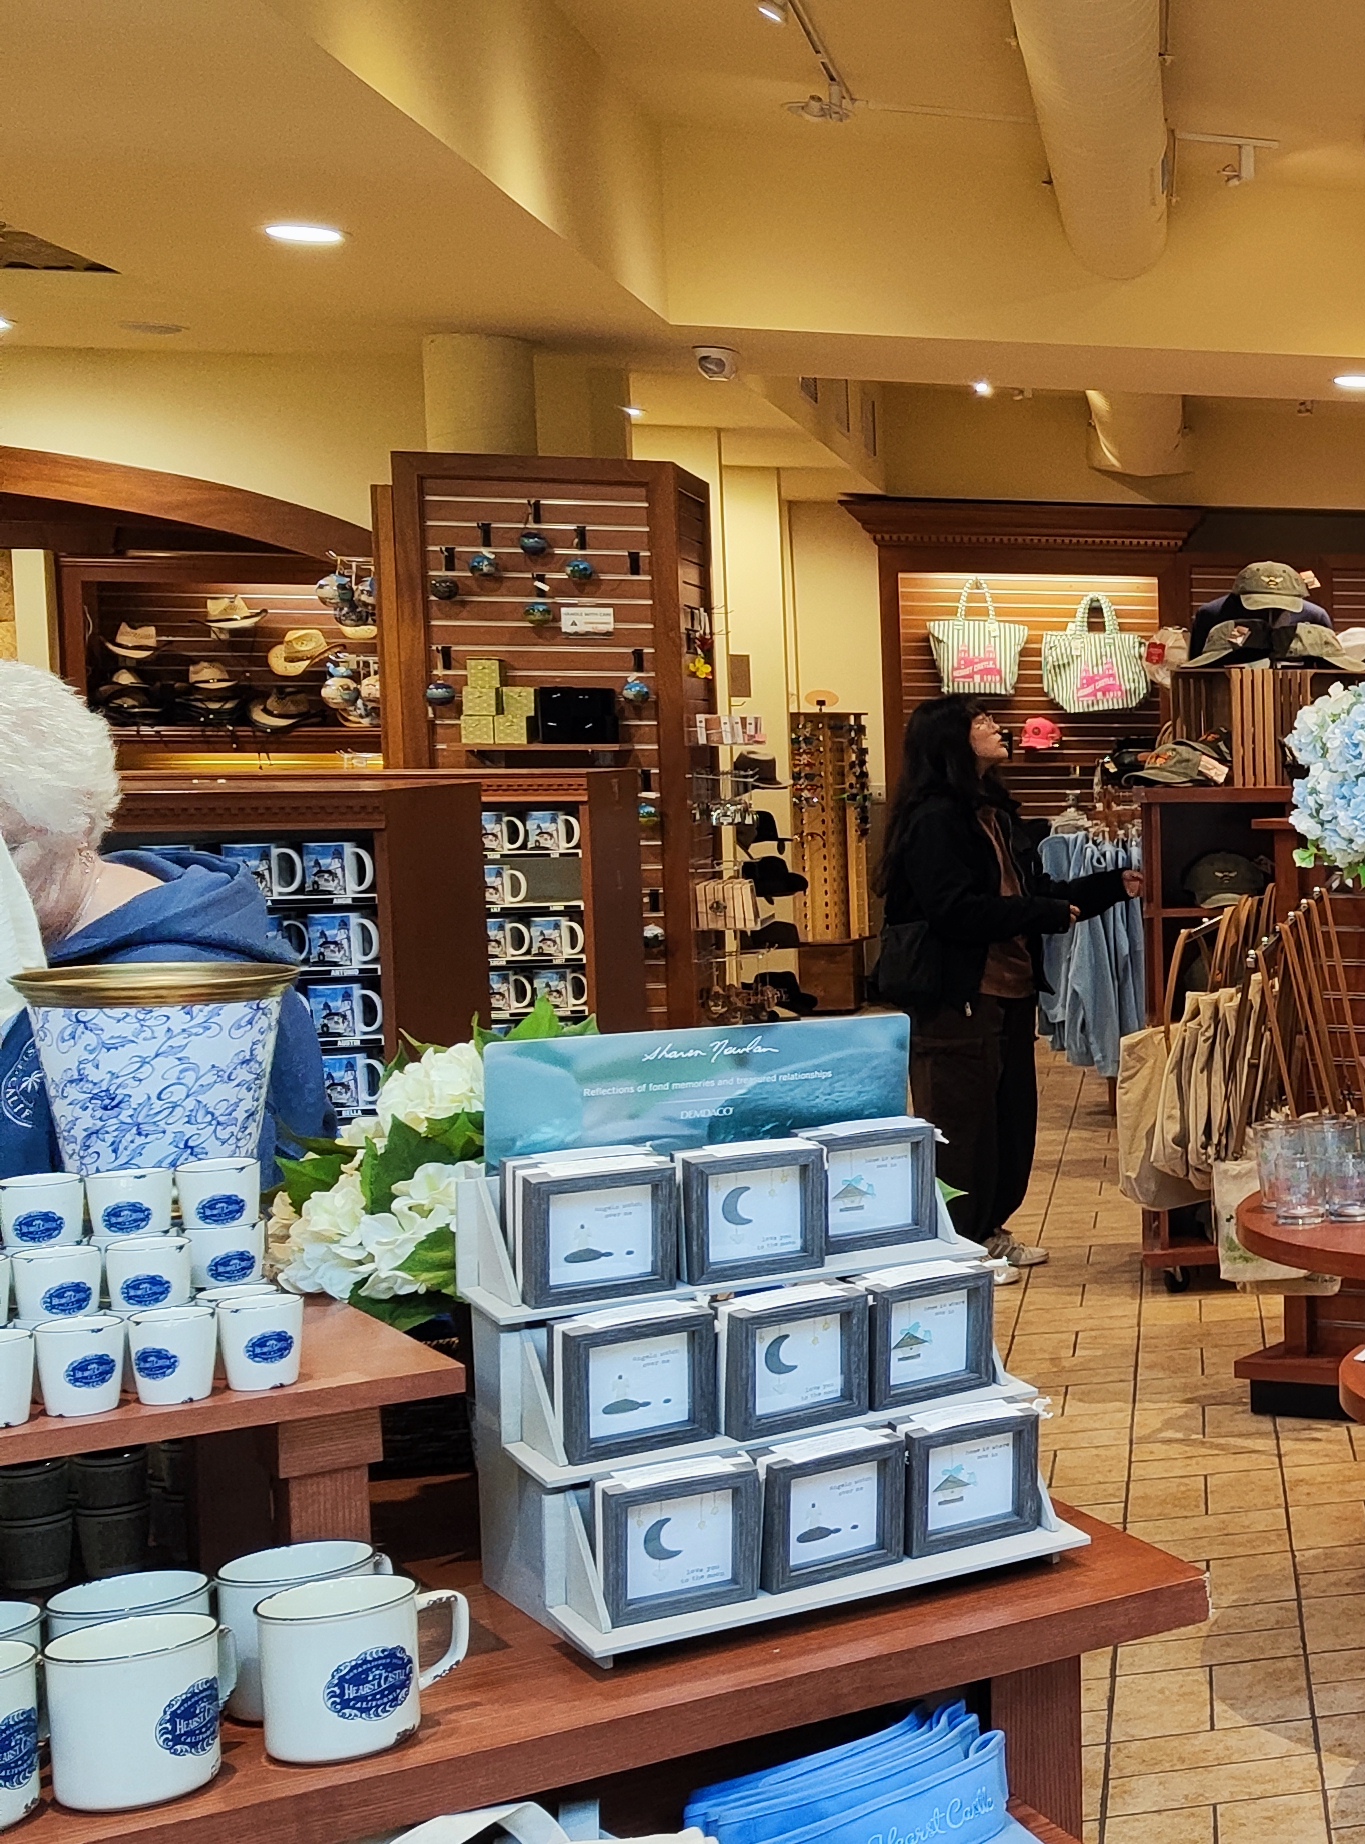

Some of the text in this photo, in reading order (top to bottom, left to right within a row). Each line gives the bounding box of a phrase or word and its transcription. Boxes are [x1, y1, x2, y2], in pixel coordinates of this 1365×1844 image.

[583, 1070, 833, 1098] Reflections of fond memories and treasured relationships
[680, 1107, 733, 1120] DEMDACO
[343, 1679, 380, 1700] HEARST
[175, 1714, 205, 1735] HEARST
[0, 1747, 19, 1763] EARST
[946, 1786, 995, 1829] Castle
